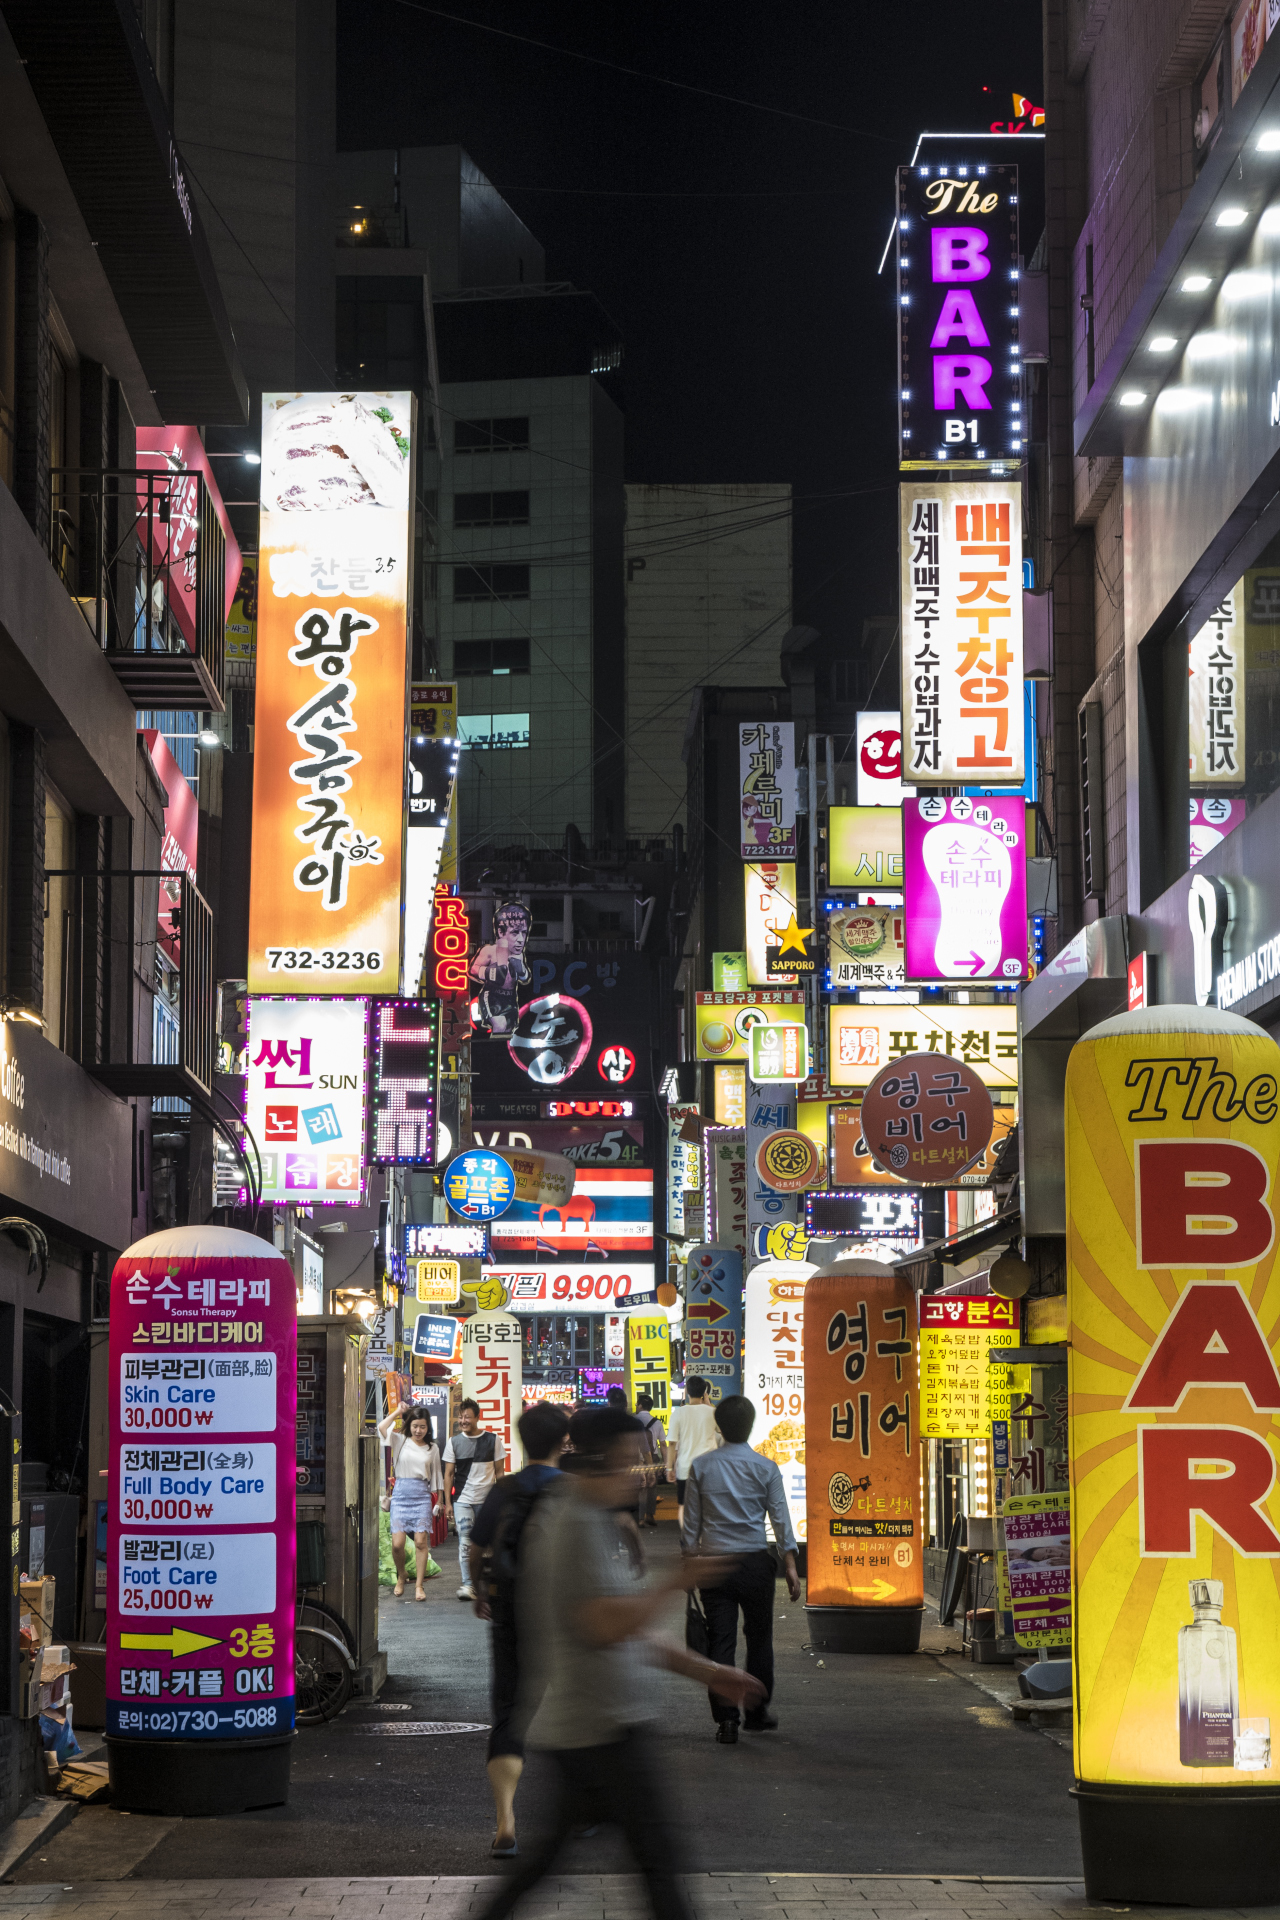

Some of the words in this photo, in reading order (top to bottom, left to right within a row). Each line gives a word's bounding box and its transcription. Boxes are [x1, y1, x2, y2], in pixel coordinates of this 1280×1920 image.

[926, 178, 999, 215] The
[930, 226, 993, 411] BAR
[945, 419, 979, 443] B1
[954, 502, 1014, 768] 맥주창고
[288, 610, 373, 904] 왕소금구이
[742, 724, 781, 824] 카페루미
[769, 827, 792, 844] 3F
[744, 845, 795, 855] 722-3177
[946, 838, 993, 868] 손수
[940, 869, 1002, 888] 테라피
[268, 949, 382, 973] 732-3236
[771, 961, 815, 971] SAPPORO
[1005, 961, 1020, 974] 3F
[838, 964, 885, 982] 세계맥주
[1217, 951, 1258, 1011] PREMIUM
[703, 993, 757, 1004] 프로당구장
[762, 993, 793, 1003] 포켓볼
[252, 1037, 312, 1089] 썬
[318, 1075, 357, 1089] SUN
[881, 1072, 970, 1109] 영구
[1125, 1057, 1278, 1124] The
[265, 1108, 338, 1138] 노래
[886, 1112, 967, 1142] 비어
[622, 1145, 639, 1160] 4F
[912, 1147, 969, 1166] 다트설치
[462, 1157, 498, 1174] 종각
[448, 1175, 510, 1202] 골프존
[481, 1205, 495, 1215] B1
[636, 1226, 648, 1234] 3F
[424, 1267, 452, 1279] 비어
[126, 1270, 271, 1310] 손수테라피
[552, 1274, 632, 1301] 9,900
[623, 1294, 651, 1306] 도우미
[171, 1308, 198, 1316] Sonsu
[200, 1308, 237, 1318] Therapy
[132, 1322, 263, 1343] 스킨바디케어
[630, 1324, 667, 1340] MBC
[827, 1301, 912, 1383] 영구
[926, 1334, 981, 1345] 제육덮밥
[985, 1335, 1012, 1346] 4,500
[690, 1330, 735, 1358] 당구장
[1120, 1137, 1280, 1559] BAR
[926, 1349, 979, 1360] 오징어덮밥
[125, 1359, 205, 1379] 피부관리
[633, 1348, 668, 1409] 노래
[926, 1364, 979, 1375] 돈까스
[125, 1385, 159, 1403] Skin
[167, 1385, 216, 1403] Care
[926, 1379, 980, 1390] 김치볶음밥
[926, 1393, 980, 1405] 김치찌개
[985, 1394, 1011, 1405] 4,500
[926, 1408, 980, 1420] 된장찌개
[985, 1409, 1011, 1420] 4,500
[831, 1392, 912, 1459] 비어
[926, 1423, 980, 1434] 순두부
[994, 1424, 1007, 1465] 냉방중
[1010, 1393, 1050, 1494] 수제
[125, 1450, 206, 1471] 전체관리
[207, 1451, 254, 1470] (全身)
[124, 1477, 152, 1495] Full
[160, 1477, 212, 1496] Body
[220, 1476, 264, 1494] Care
[857, 1495, 912, 1515] 다트설치
[1005, 1523, 1034, 1532] FOOT
[1042, 1519, 1070, 1528] CARE
[124, 1540, 182, 1561] 발관리
[183, 1541, 214, 1560] (足)
[897, 1549, 911, 1562] B1
[832, 1555, 865, 1566] 단체석
[868, 1555, 890, 1567] 완비
[123, 1566, 161, 1585] Foot
[168, 1567, 218, 1585] Care
[229, 1623, 276, 1658] 3층
[234, 1665, 275, 1695] OK!
